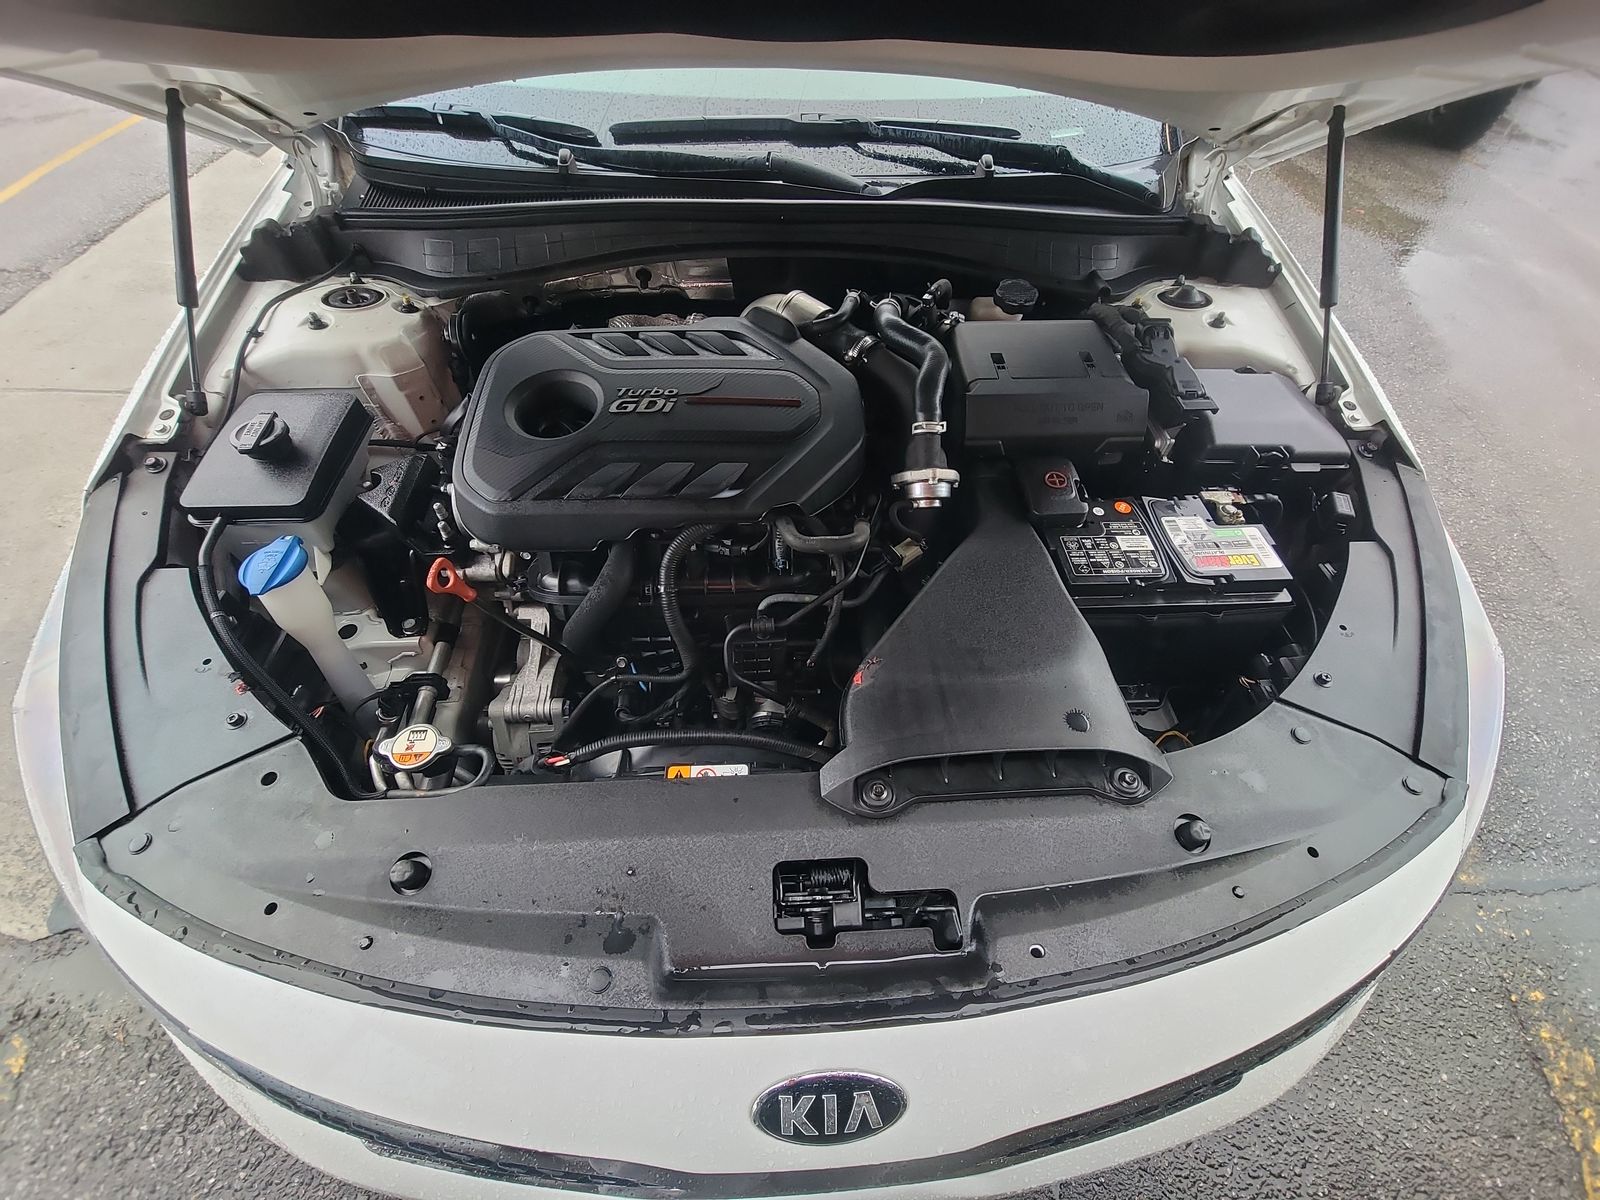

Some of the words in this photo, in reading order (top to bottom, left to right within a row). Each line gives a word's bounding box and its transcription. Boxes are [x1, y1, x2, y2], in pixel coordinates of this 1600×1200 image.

[616, 386, 679, 397] Turbo
[608, 397, 678, 413] GDi
[1193, 554, 1261, 568] EverStart
[778, 1090, 884, 1135] KIA
